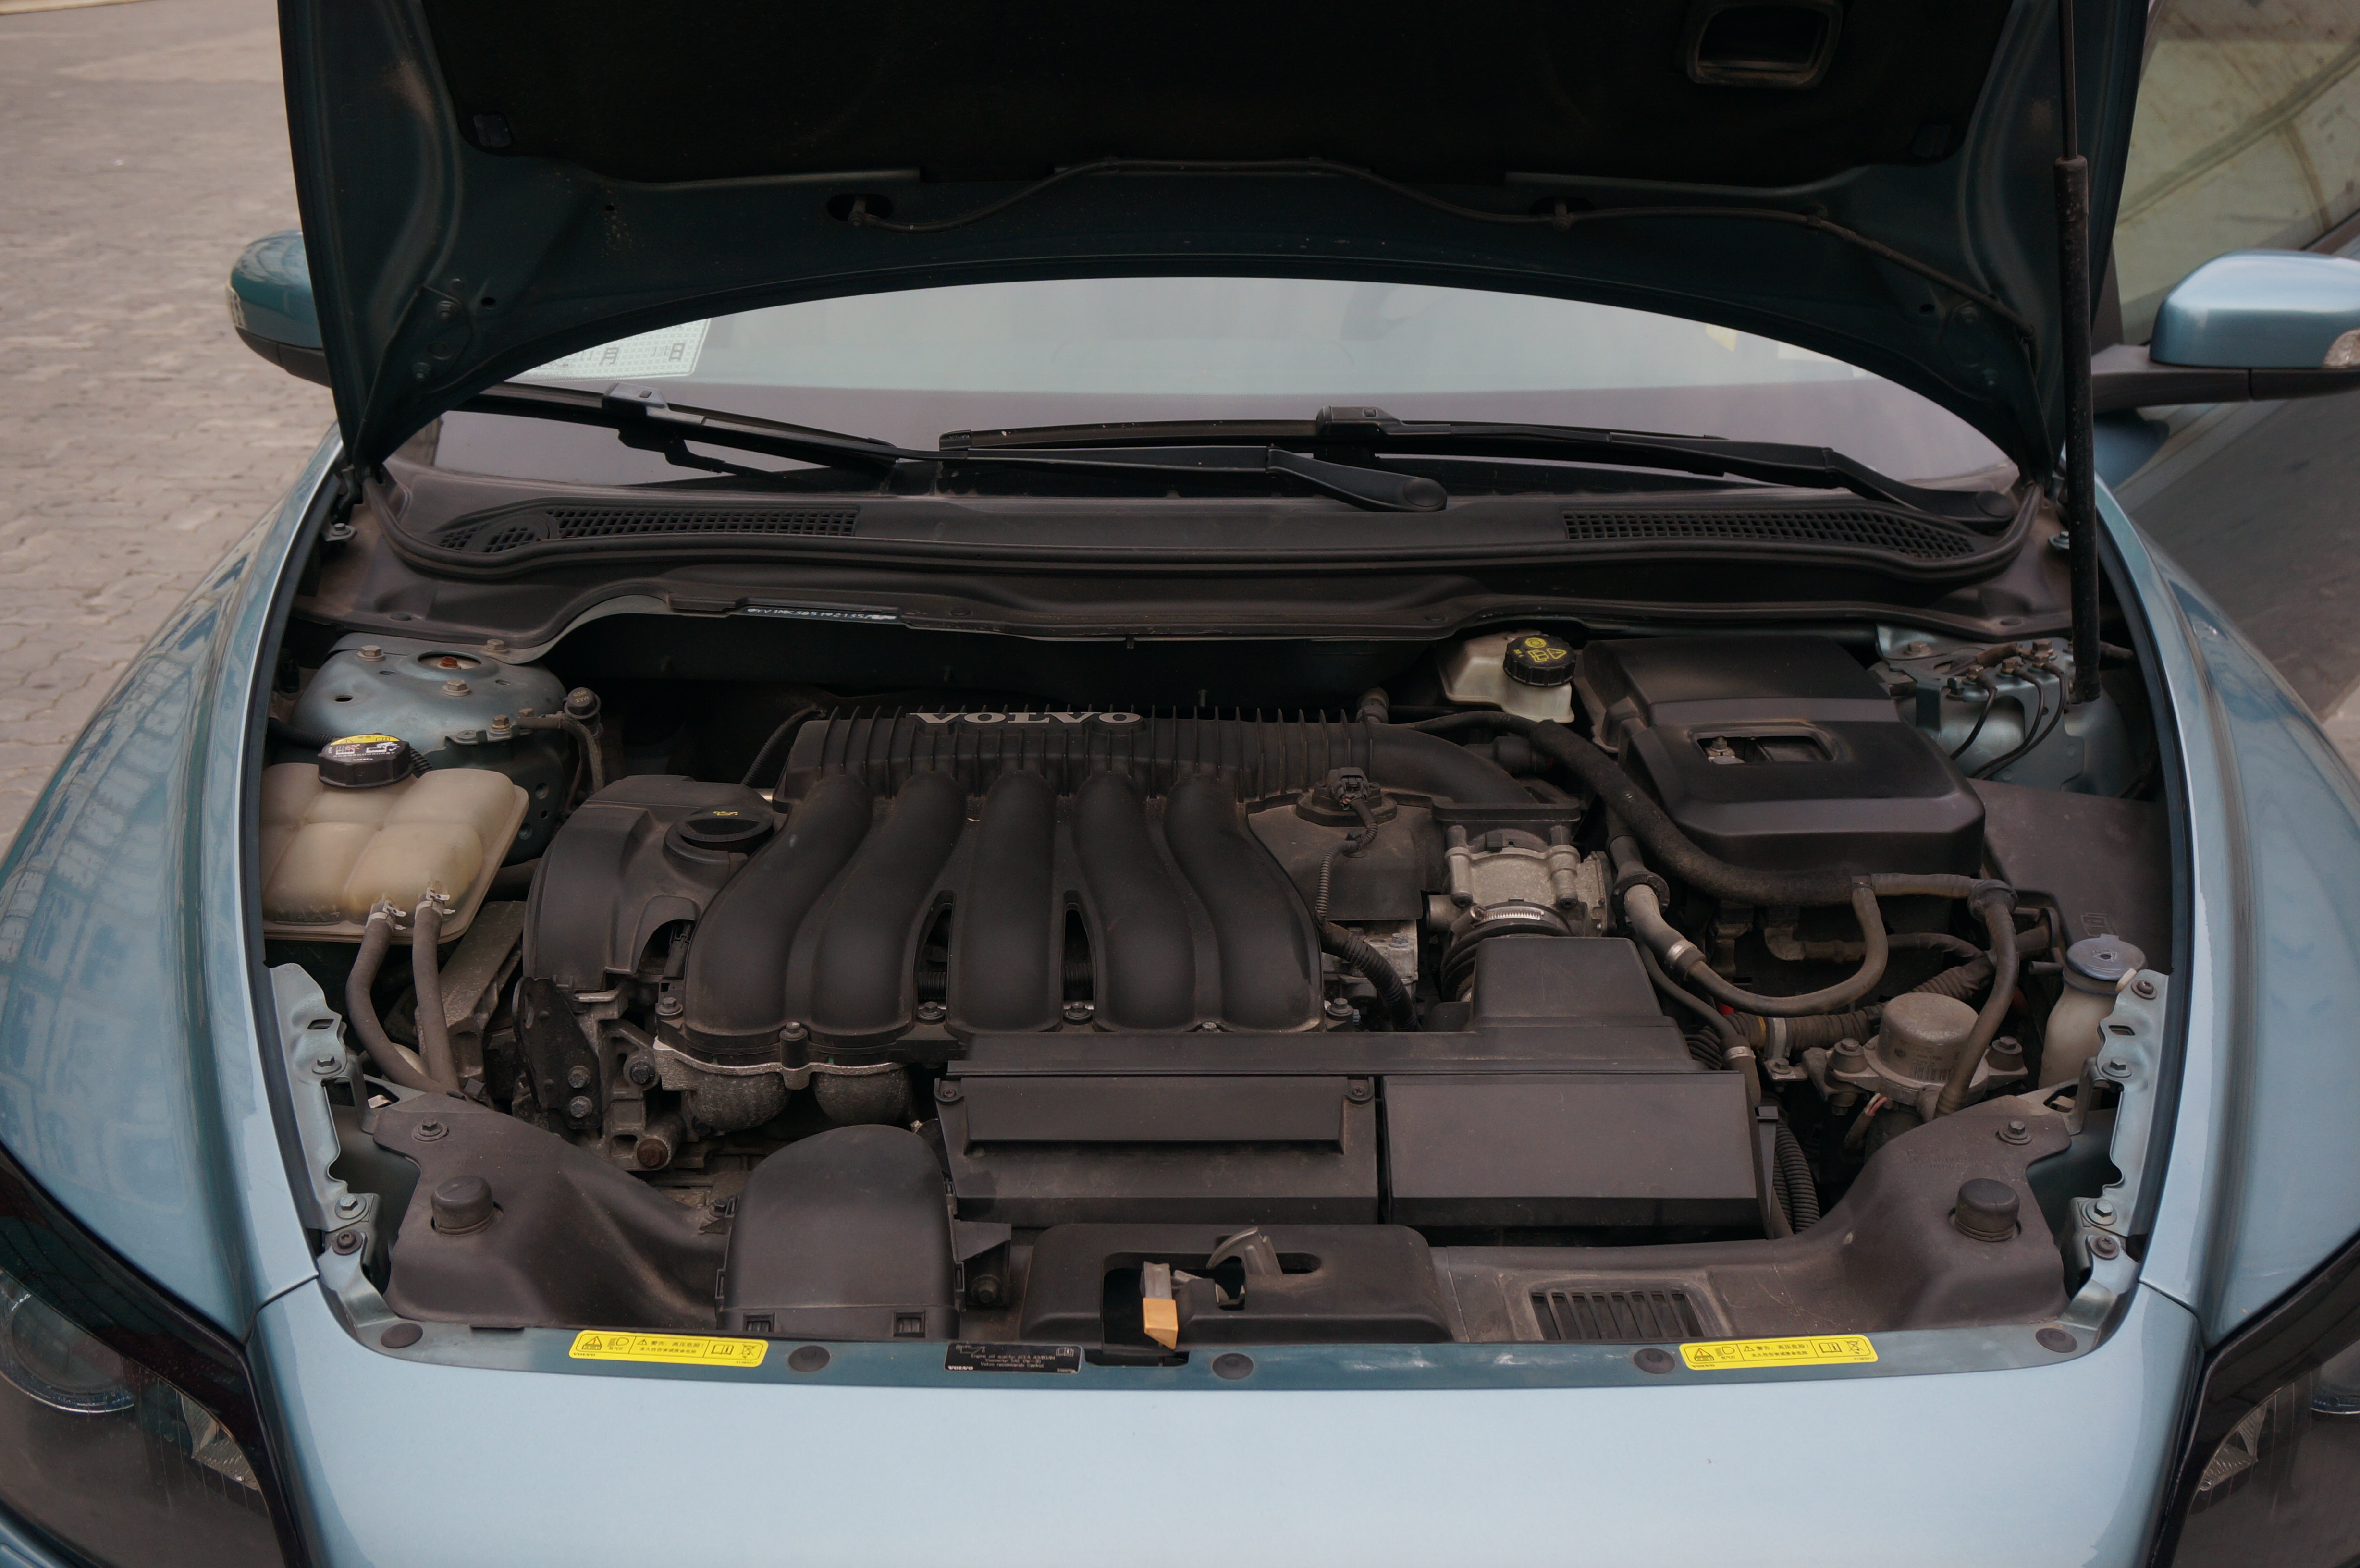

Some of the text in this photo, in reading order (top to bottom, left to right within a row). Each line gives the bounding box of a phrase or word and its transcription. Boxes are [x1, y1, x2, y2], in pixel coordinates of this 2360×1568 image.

[599, 347, 619, 366] 月
[668, 342, 686, 362] 日
[909, 712, 1141, 724] VOLVO
